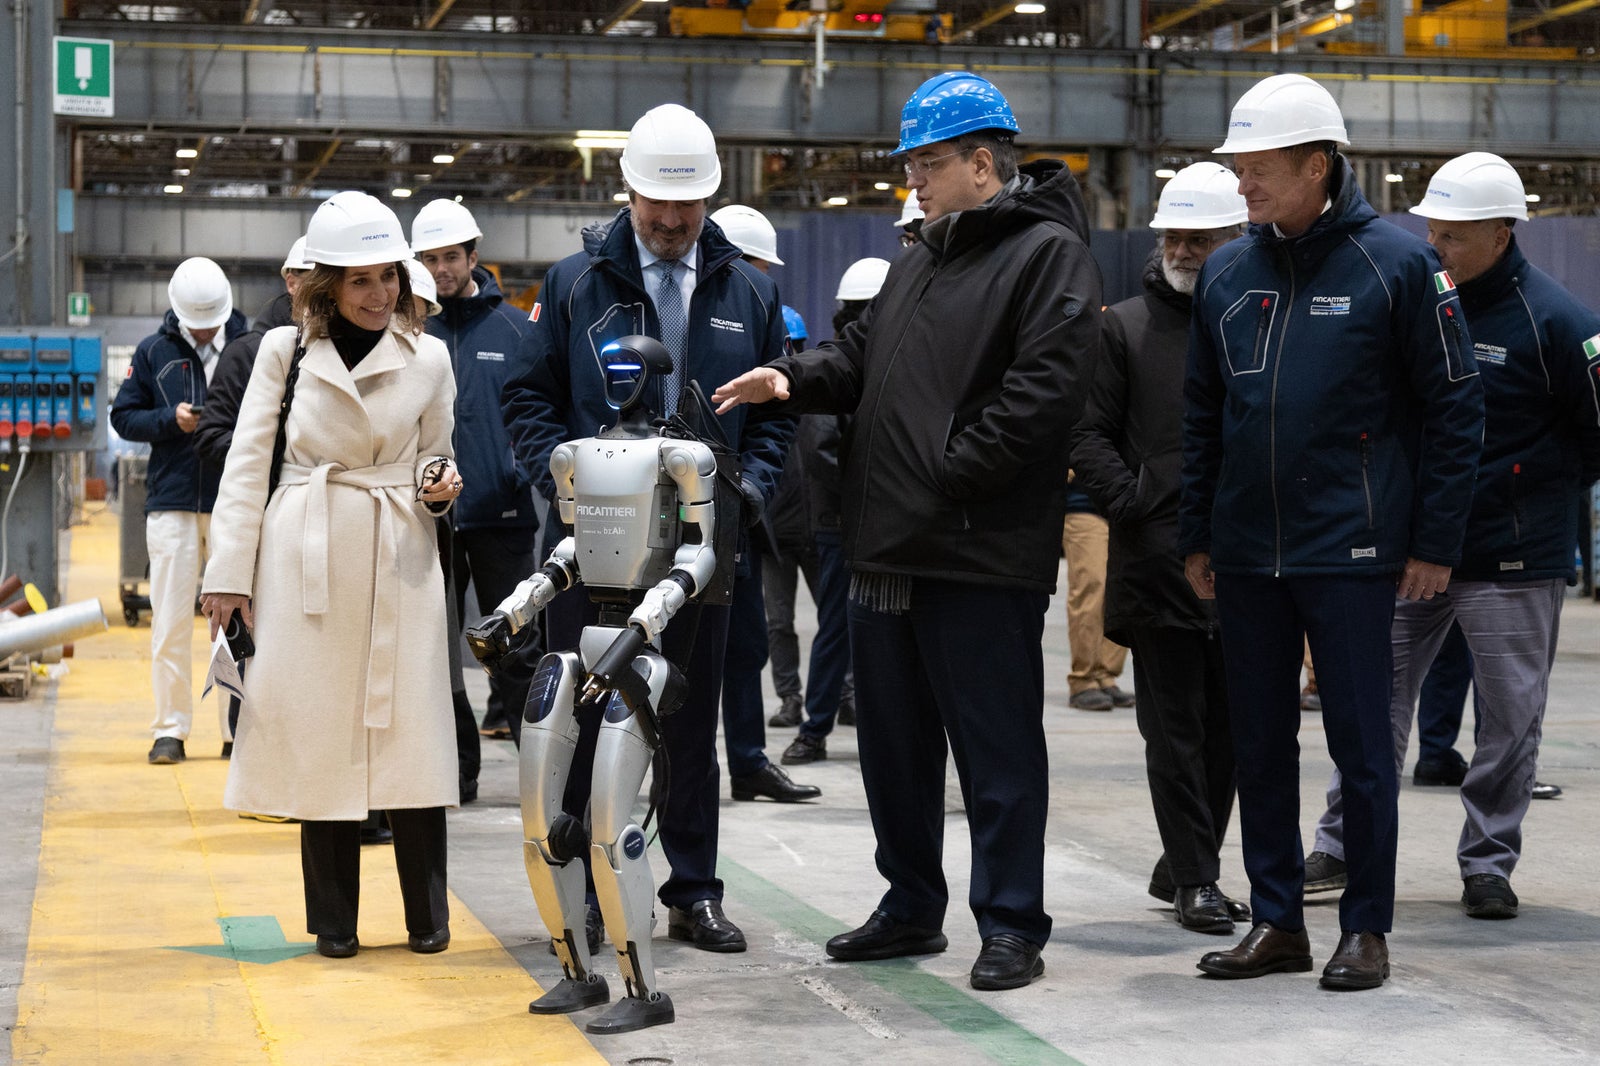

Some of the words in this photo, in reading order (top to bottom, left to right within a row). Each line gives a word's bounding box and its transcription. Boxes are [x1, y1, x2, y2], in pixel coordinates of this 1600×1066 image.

[710, 317, 744, 328] FINCANTIERI
[1474, 342, 1507, 353] FINCANTIERI
[576, 505, 637, 517] FINCANTIERI
